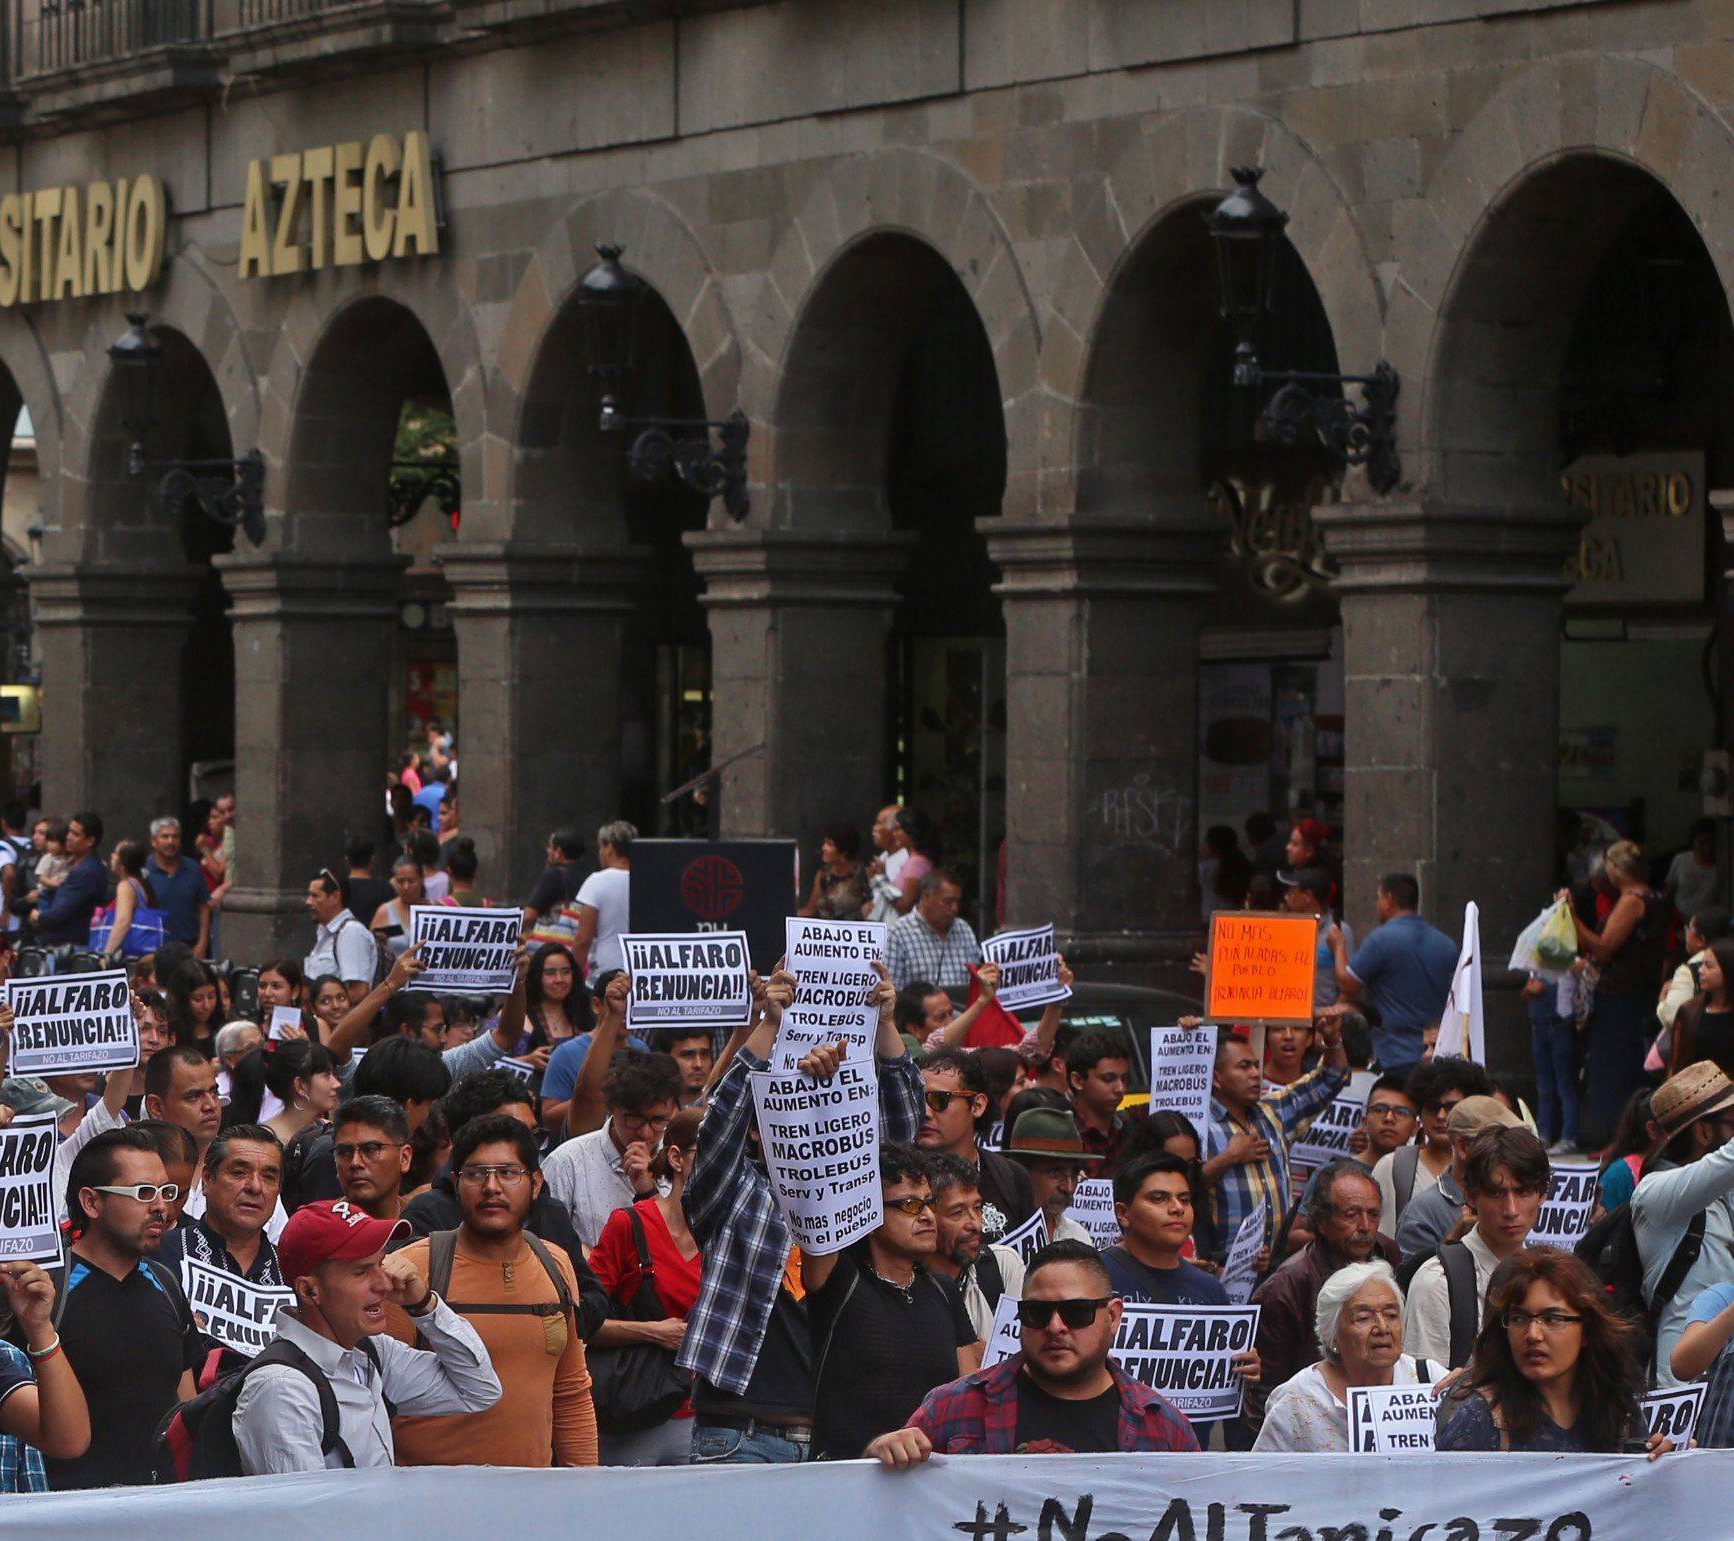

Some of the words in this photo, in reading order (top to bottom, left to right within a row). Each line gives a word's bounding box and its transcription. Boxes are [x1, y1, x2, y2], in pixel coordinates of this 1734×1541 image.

[238, 130, 438, 279] AZTECA
[420, 916, 518, 944] ¡¡ALFARO
[801, 926, 853, 943] ABAJO
[857, 930, 877, 945] EL
[1218, 922, 1235, 941] NO
[632, 943, 742, 970] ¡¡ALFARO
[794, 943, 860, 960] AUMENTO
[862, 946, 883, 962] EN:
[993, 935, 1052, 964] ¡¡ALFAR
[635, 974, 745, 1001] RENUNCIA!!
[794, 969, 829, 986] TREN
[831, 971, 878, 987] LIGERO
[15, 981, 128, 1018] ¡¡ALFARO
[657, 1007, 670, 1016] NO
[670, 1006, 682, 1015] AL
[683, 1005, 722, 1016] TARIFAZO
[790, 1010, 866, 1026] TROLEBÚS
[17, 1015, 128, 1050] RENUNCIA!!
[785, 1029, 814, 1042] Serv
[815, 1033, 824, 1045] y
[826, 1030, 867, 1048] Transp
[1162, 1032, 1192, 1044] ABAJO
[1194, 1032, 1210, 1043] EL
[42, 1056, 56, 1064] NO
[57, 1054, 68, 1063] AL
[69, 1050, 109, 1063] TARIFAZO
[782, 1053, 796, 1070] No
[1157, 1045, 1195, 1057] AUMENTO
[768, 1074, 834, 1096] ABAJO
[838, 1068, 865, 1086] EL
[1159, 1066, 1177, 1077] TREN
[1178, 1064, 1208, 1076] LIGERO
[763, 1090, 843, 1113] AUMENTO
[847, 1084, 875, 1102] EN:
[769, 1122, 811, 1139] TREN
[815, 1110, 872, 1136] LIGERO
[771, 1126, 875, 1161] MACROBÚS
[776, 1152, 873, 1182] TROLEBÚS
[778, 1183, 812, 1200] Serv
[815, 1187, 826, 1202] y
[828, 1169, 876, 1196] Transp
[1075, 1184, 1111, 1198] ABAJO
[788, 1209, 803, 1228] No
[804, 1214, 829, 1231] mas
[834, 1196, 873, 1227] negocio
[815, 1230, 831, 1245] el
[834, 1210, 879, 1243] pueblo
[195, 1274, 292, 1326] ¡¡ALFA
[1381, 1406, 1438, 1422] AUMEN
[1387, 1433, 1430, 1448] TREN
